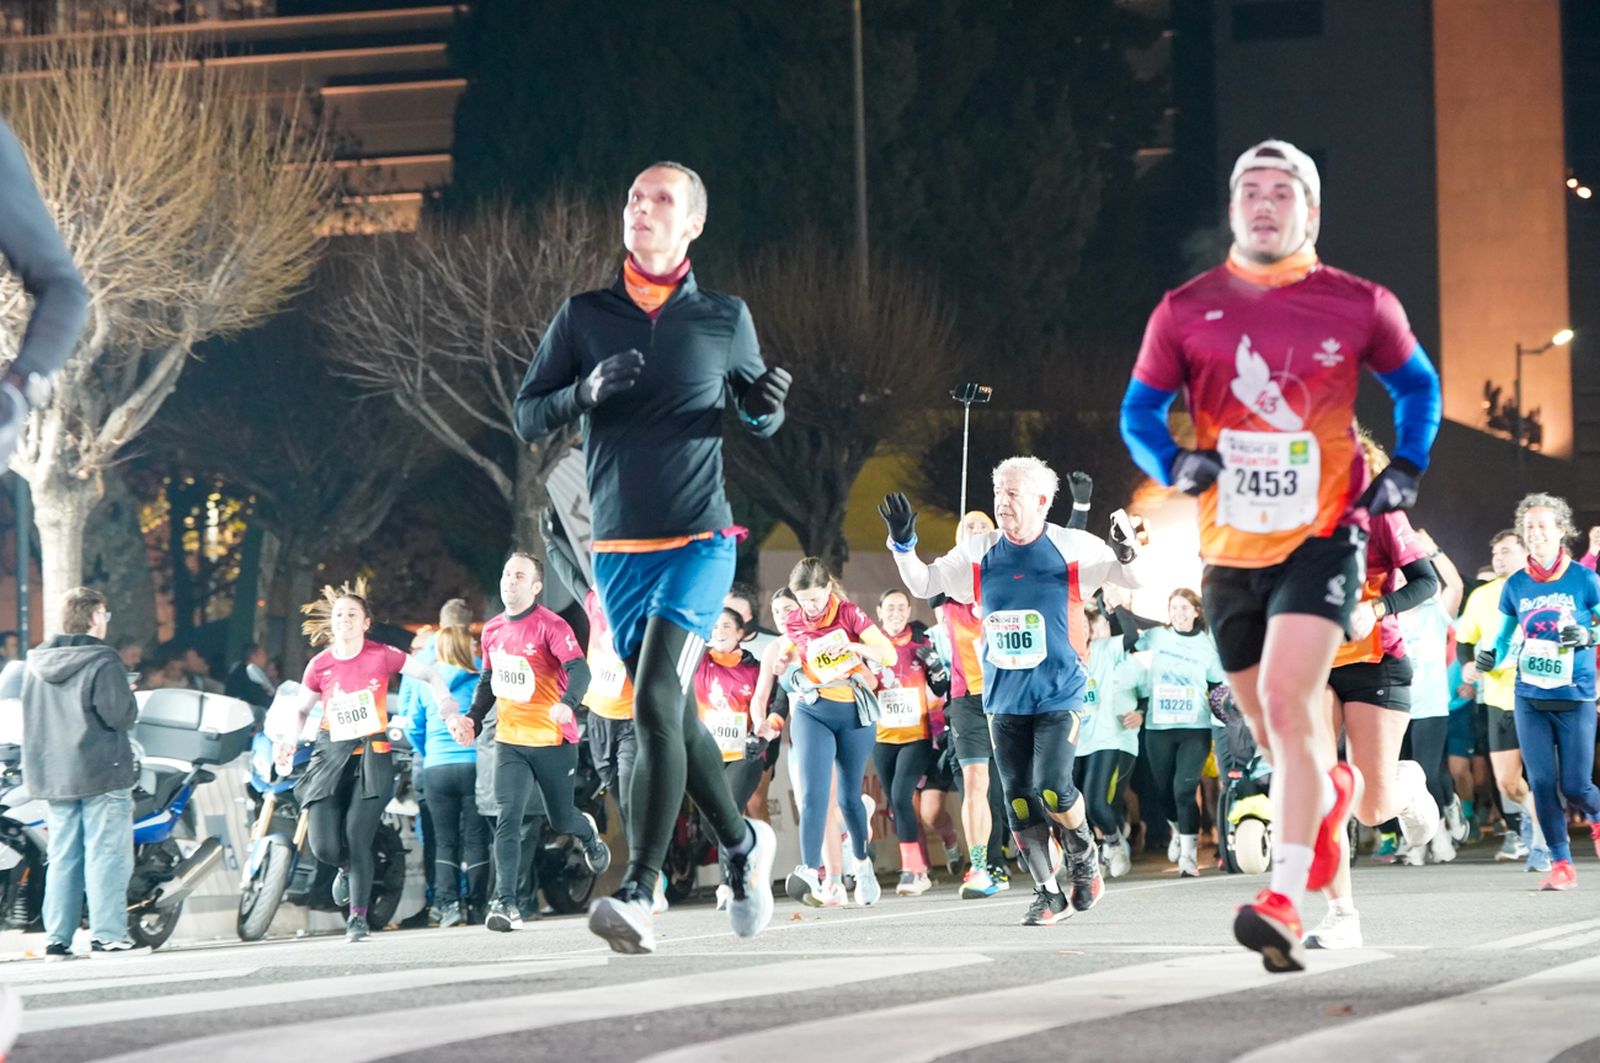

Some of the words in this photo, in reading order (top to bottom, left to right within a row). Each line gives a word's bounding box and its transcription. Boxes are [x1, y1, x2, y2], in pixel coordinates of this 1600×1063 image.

[1235, 468, 1298, 497] 2453
[996, 631, 1032, 649] 3106
[1528, 656, 1562, 674] 8366
[1159, 698, 1193, 711] 13226
[337, 706, 368, 725] 6808
